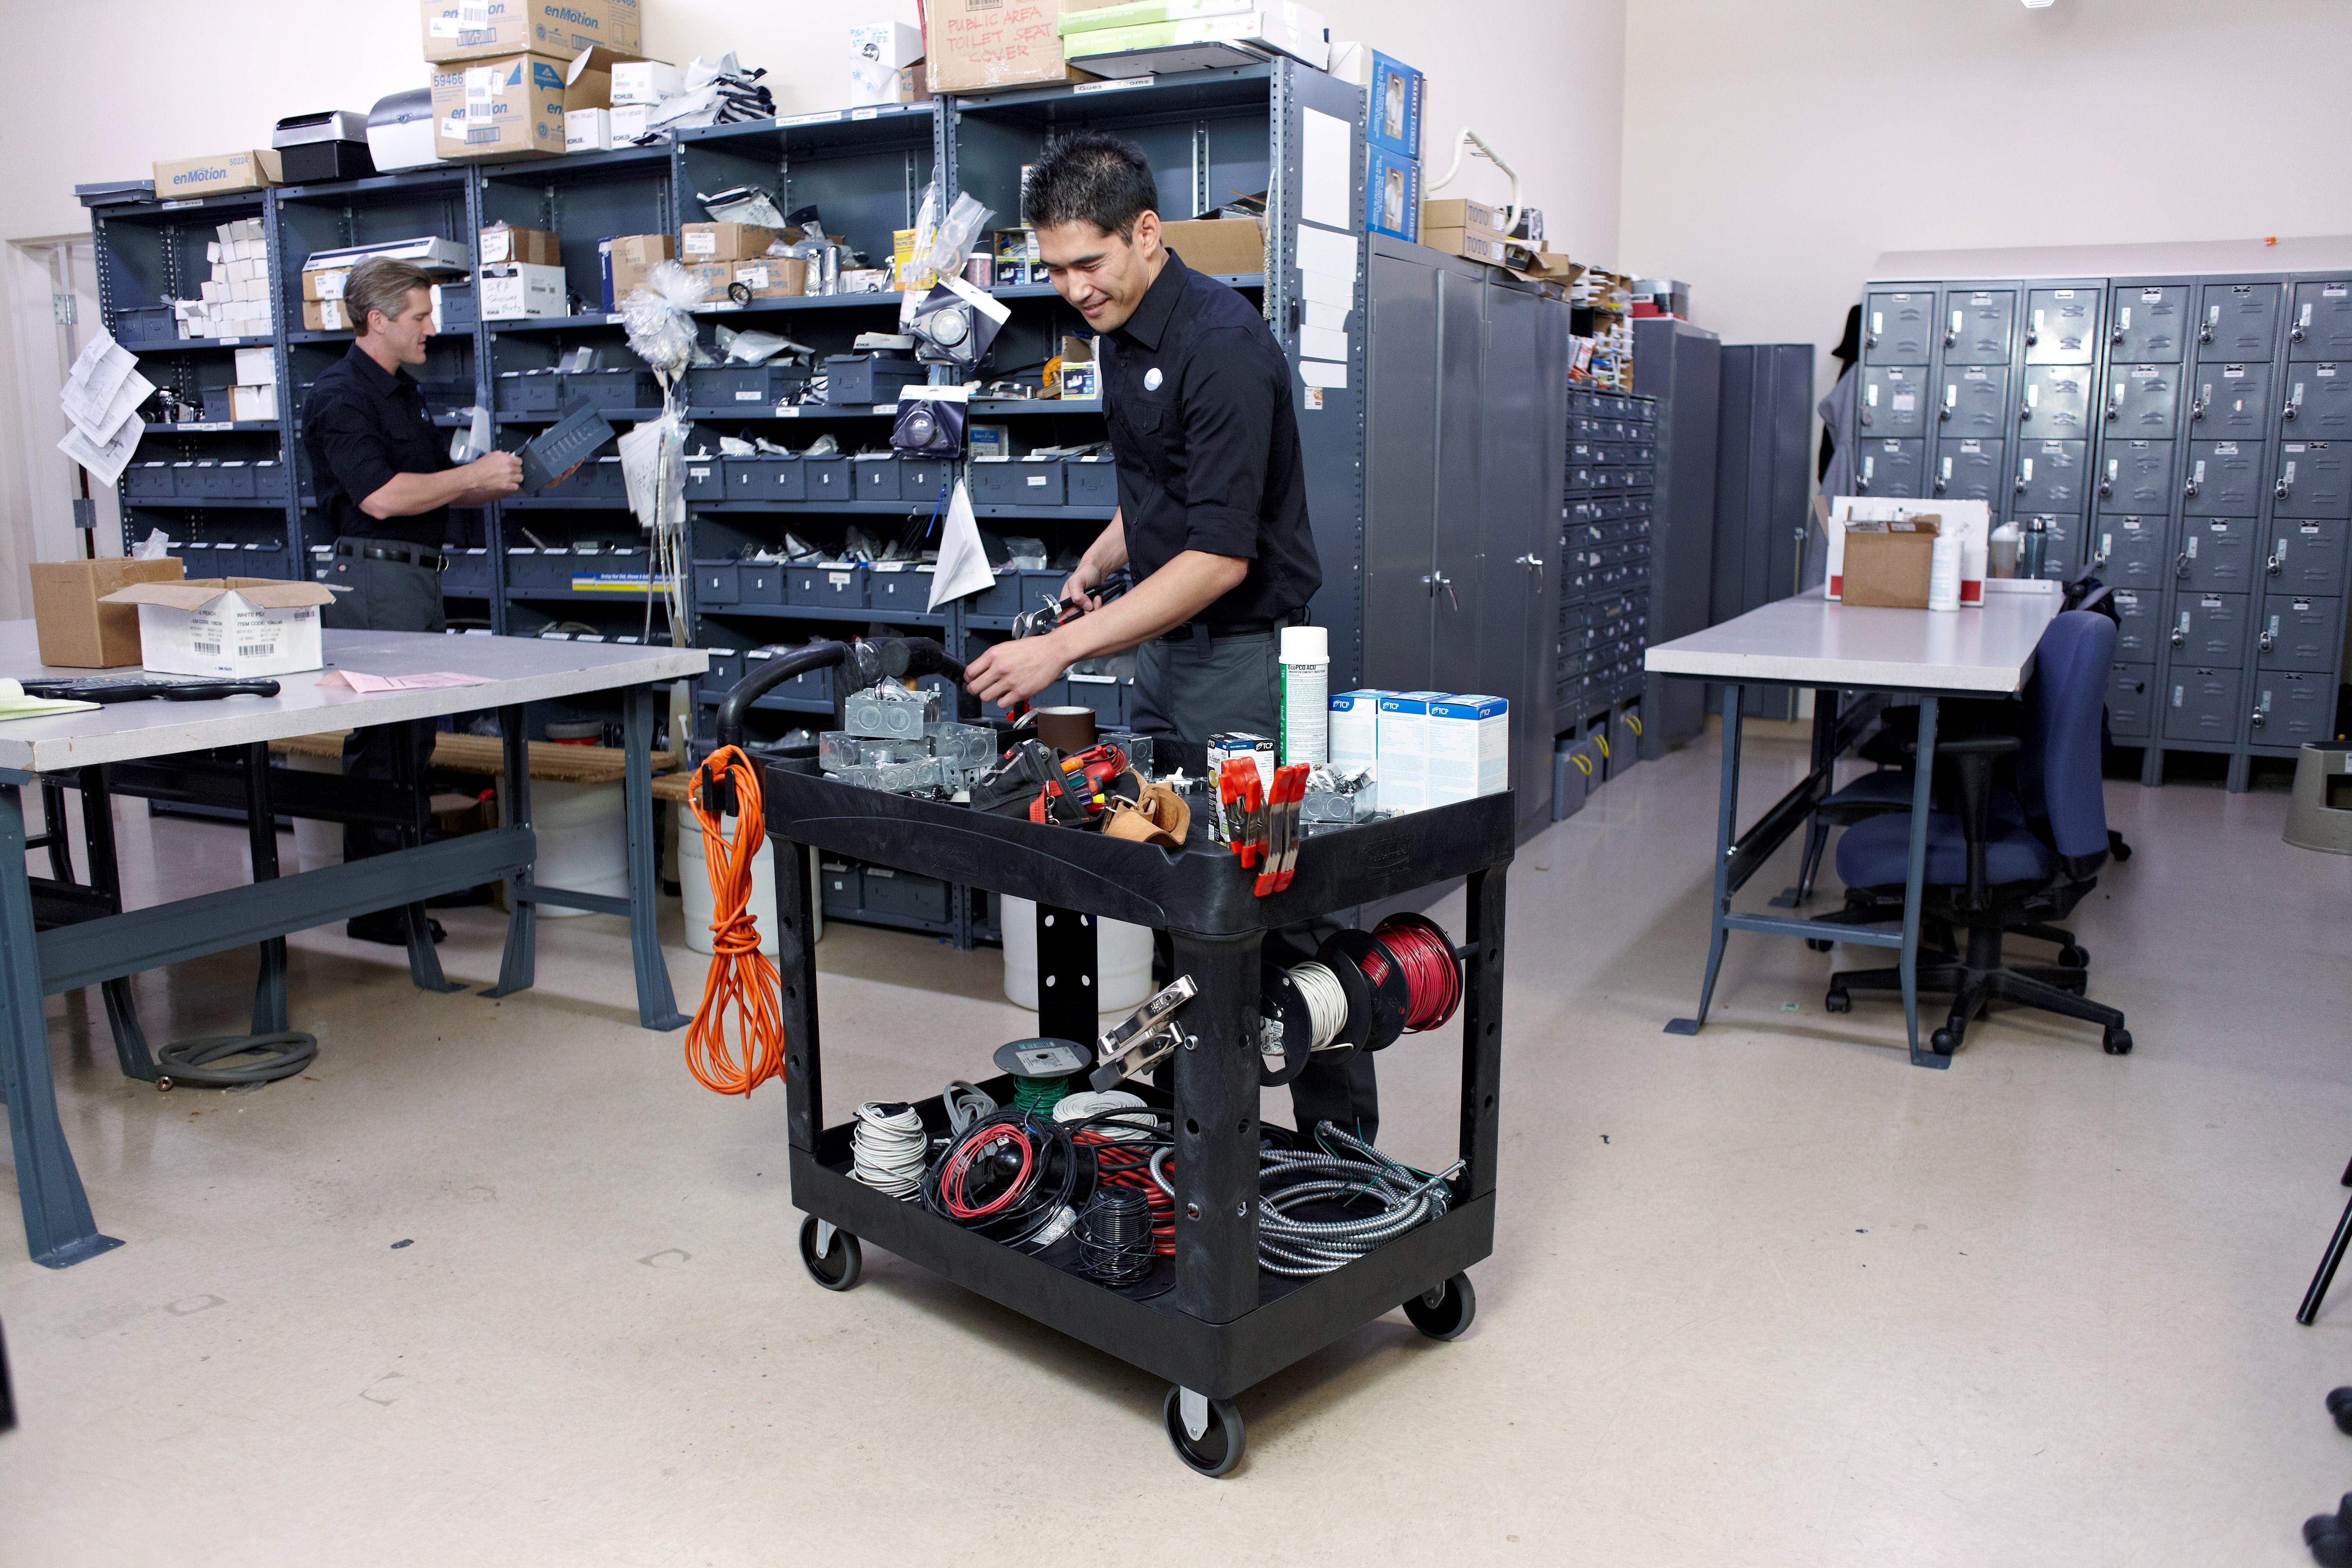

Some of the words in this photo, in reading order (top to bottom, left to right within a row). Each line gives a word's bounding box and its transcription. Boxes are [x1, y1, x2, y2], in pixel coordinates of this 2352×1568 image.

[545, 5, 599, 28] enMotion
[948, 14, 999, 33] PUBLIC
[1004, 6, 1042, 25] AREA
[947, 30, 1003, 52] TOILET
[1014, 23, 1052, 42] SEAT
[970, 45, 1029, 62] COVER
[434, 73, 463, 86] 59466
[230, 157, 248, 165] 50224
[173, 167, 227, 185] enMotion
[1468, 206, 1489, 225] TOTO
[1467, 236, 1488, 255] TOTO
[1208, 753, 1220, 764] TruStart
